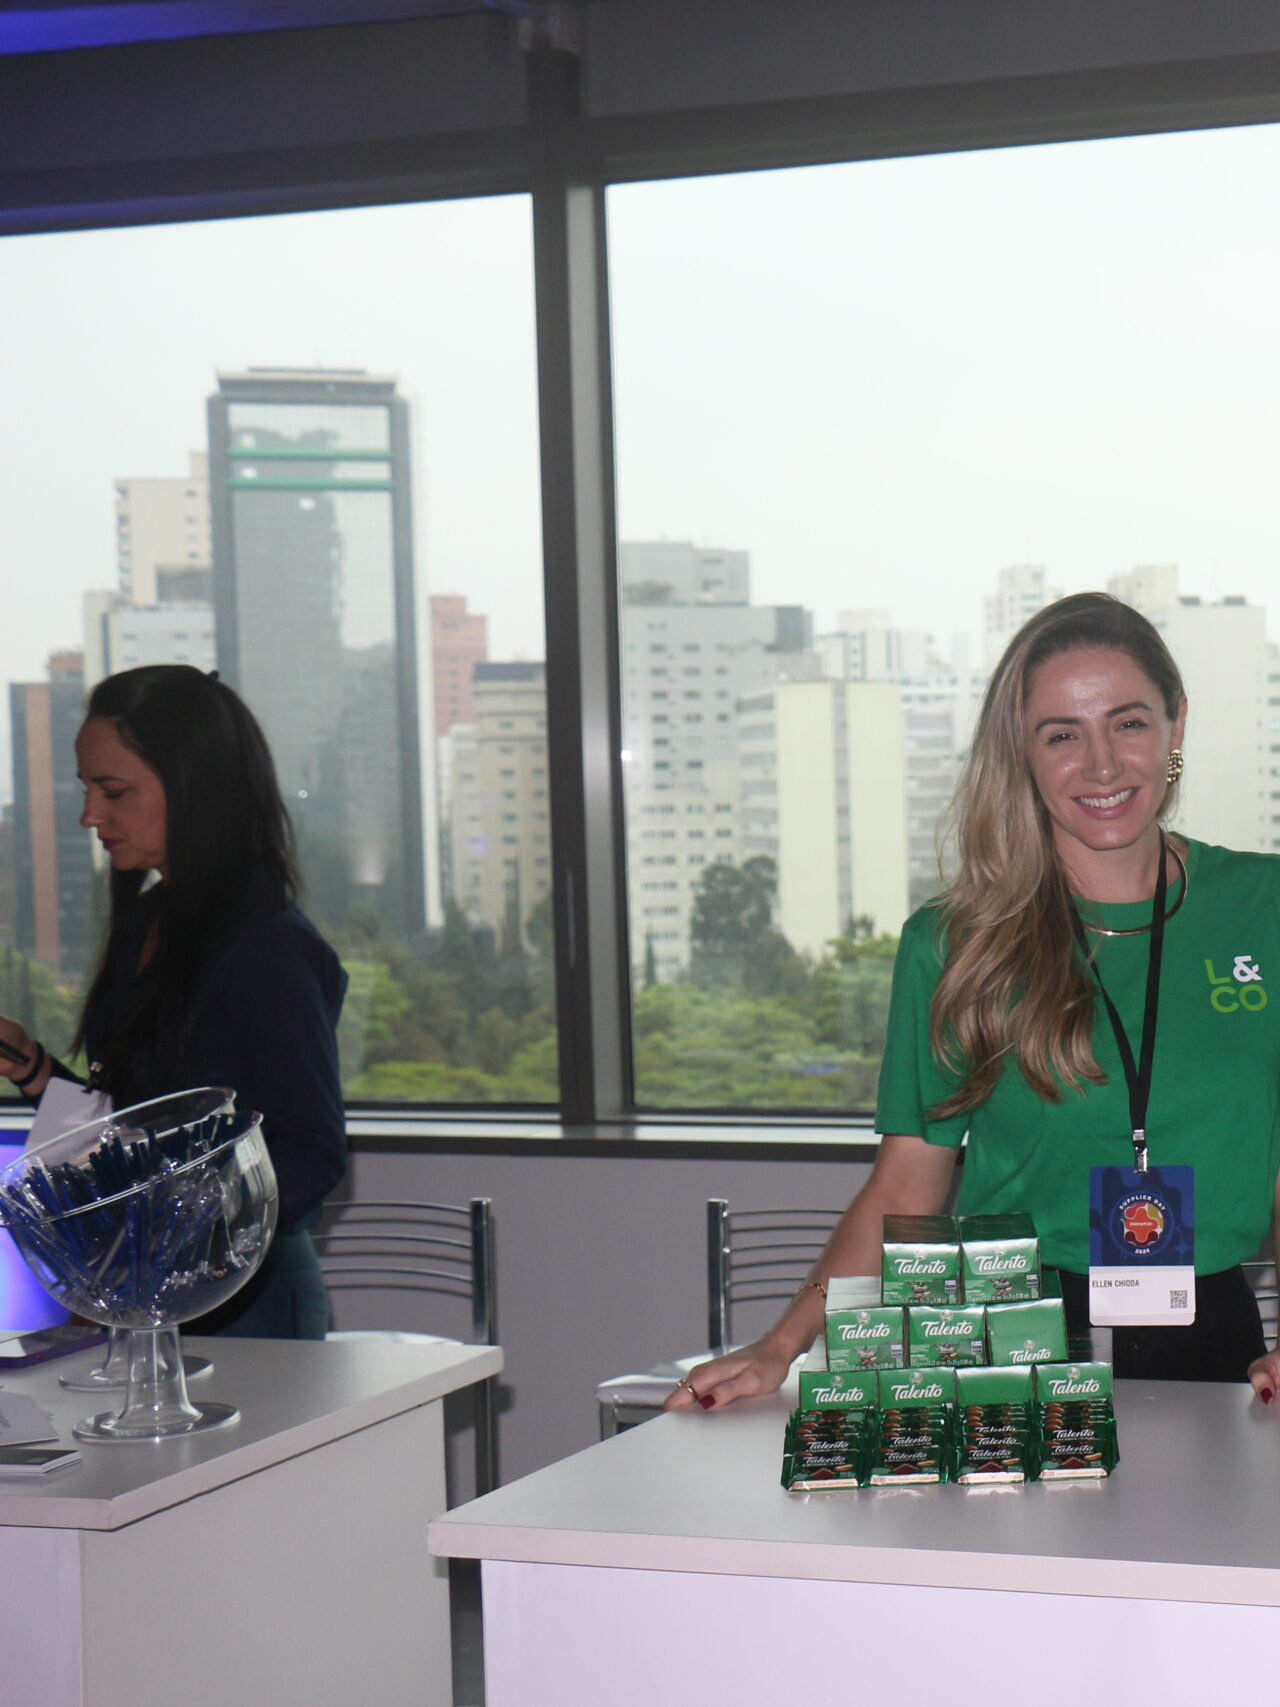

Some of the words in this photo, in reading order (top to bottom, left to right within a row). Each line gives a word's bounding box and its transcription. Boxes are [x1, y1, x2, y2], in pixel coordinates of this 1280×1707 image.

[1210, 985, 1268, 1013] CO
[1119, 1194, 1152, 1210] SUPPLIER
[1153, 1198, 1166, 1211] DAY
[894, 1258, 947, 1275] Talento
[974, 1254, 1027, 1272] Talento
[1092, 1280, 1113, 1288] ELLEN
[1114, 1279, 1140, 1288] CHIODA
[838, 1323, 890, 1341] Talento
[920, 1320, 973, 1338] Talento
[1008, 1348, 1051, 1365] Talento
[811, 1387, 864, 1404] Talento
[890, 1383, 944, 1401] Talento
[1048, 1378, 1101, 1396] Talento
[891, 1435, 933, 1446] Talento
[975, 1436, 1017, 1446] Talento
[1053, 1429, 1095, 1439] Talento
[807, 1440, 849, 1450] Talento
[969, 1449, 1012, 1458] Talento
[1051, 1445, 1094, 1454] Talento
[803, 1455, 847, 1465] Talento
[885, 1452, 928, 1461] Talento
